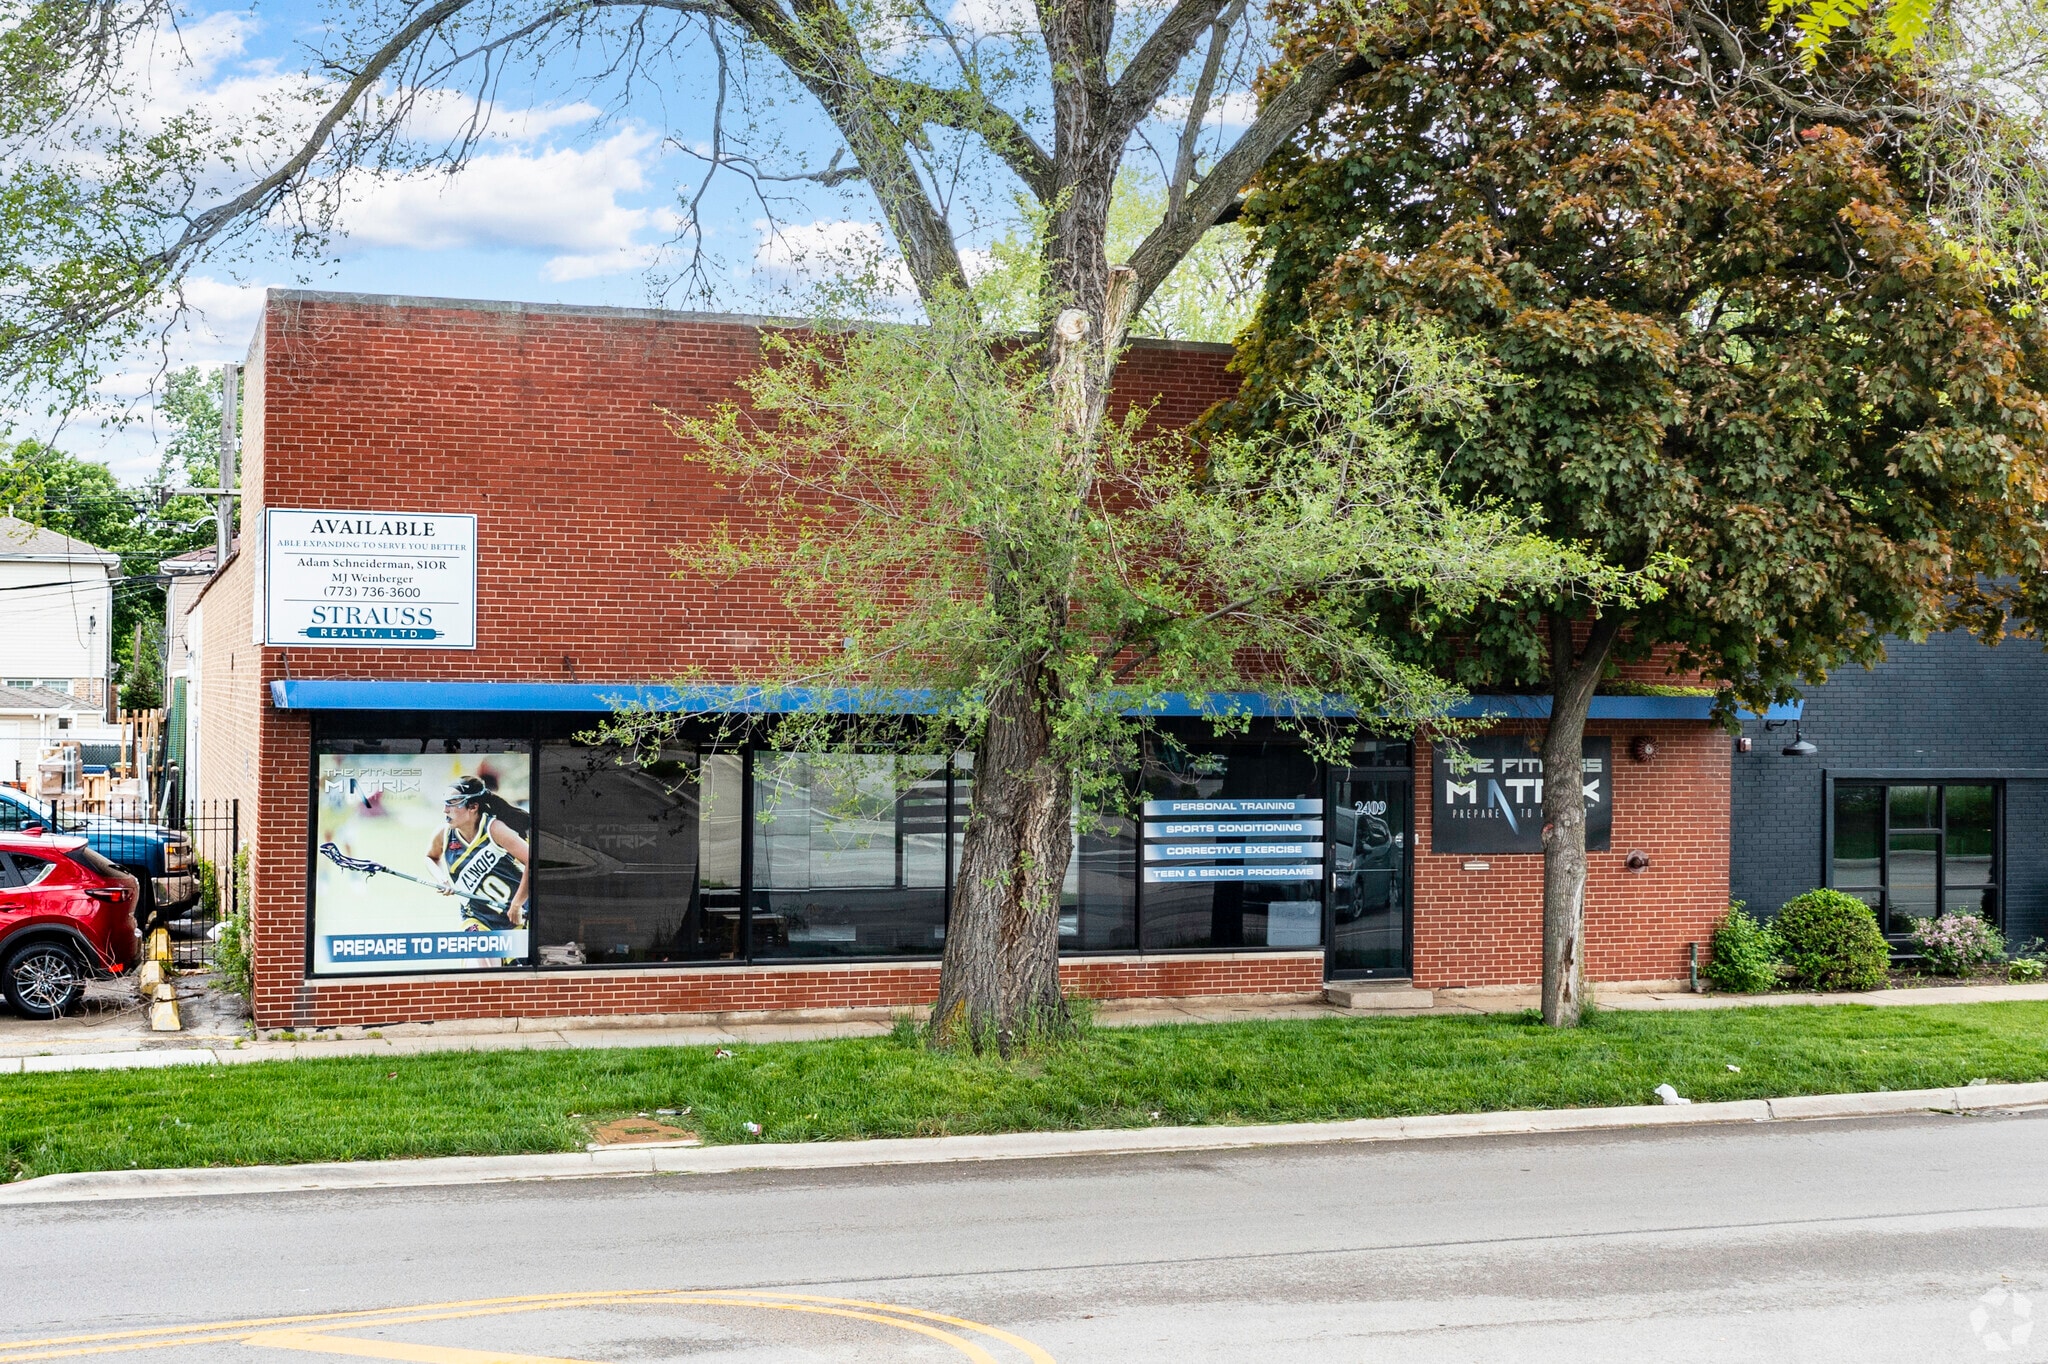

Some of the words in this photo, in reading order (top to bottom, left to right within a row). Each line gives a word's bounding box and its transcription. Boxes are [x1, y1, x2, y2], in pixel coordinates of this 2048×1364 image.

[311, 519, 436, 537] AVAILABLE
[303, 540, 360, 548] EXPANDING
[378, 542, 407, 550] SERVE
[431, 543, 467, 551] BETTER
[297, 558, 330, 568] Adam
[333, 559, 414, 570] Schneiderman,
[417, 560, 447, 570] SIOR
[332, 573, 348, 584] MJ
[351, 573, 414, 586] Weinberger
[324, 586, 358, 598] (773)
[362, 587, 421, 598] 736-3600
[311, 605, 433, 626] STRAUSS
[320, 628, 384, 638] REALTY,
[390, 630, 423, 638] LTD.
[1443, 758, 1494, 774] THE
[323, 768, 355, 777] THE
[359, 768, 422, 777] FITNESS
[324, 778, 421, 808] MATRIX
[1173, 802, 1237, 811] PERSONAL
[1240, 802, 1295, 810] TRAINING
[1355, 800, 1387, 815] 2409
[1452, 808, 1500, 819] PREPARE
[1521, 808, 1532, 818] TO
[1166, 825, 1214, 833] SPORTS
[1218, 824, 1302, 832] CONDITIONING
[1166, 847, 1242, 855] CORRECTIVE
[1245, 846, 1302, 854] EXERCISE
[1153, 870, 1185, 878] TEEN
[1188, 869, 1197, 877] &
[1200, 869, 1244, 877] SENIOR
[1247, 868, 1314, 876] PROGRAMS
[332, 938, 407, 956] PREPARE
[411, 937, 433, 954] TO
[437, 935, 513, 953] PERFORM
